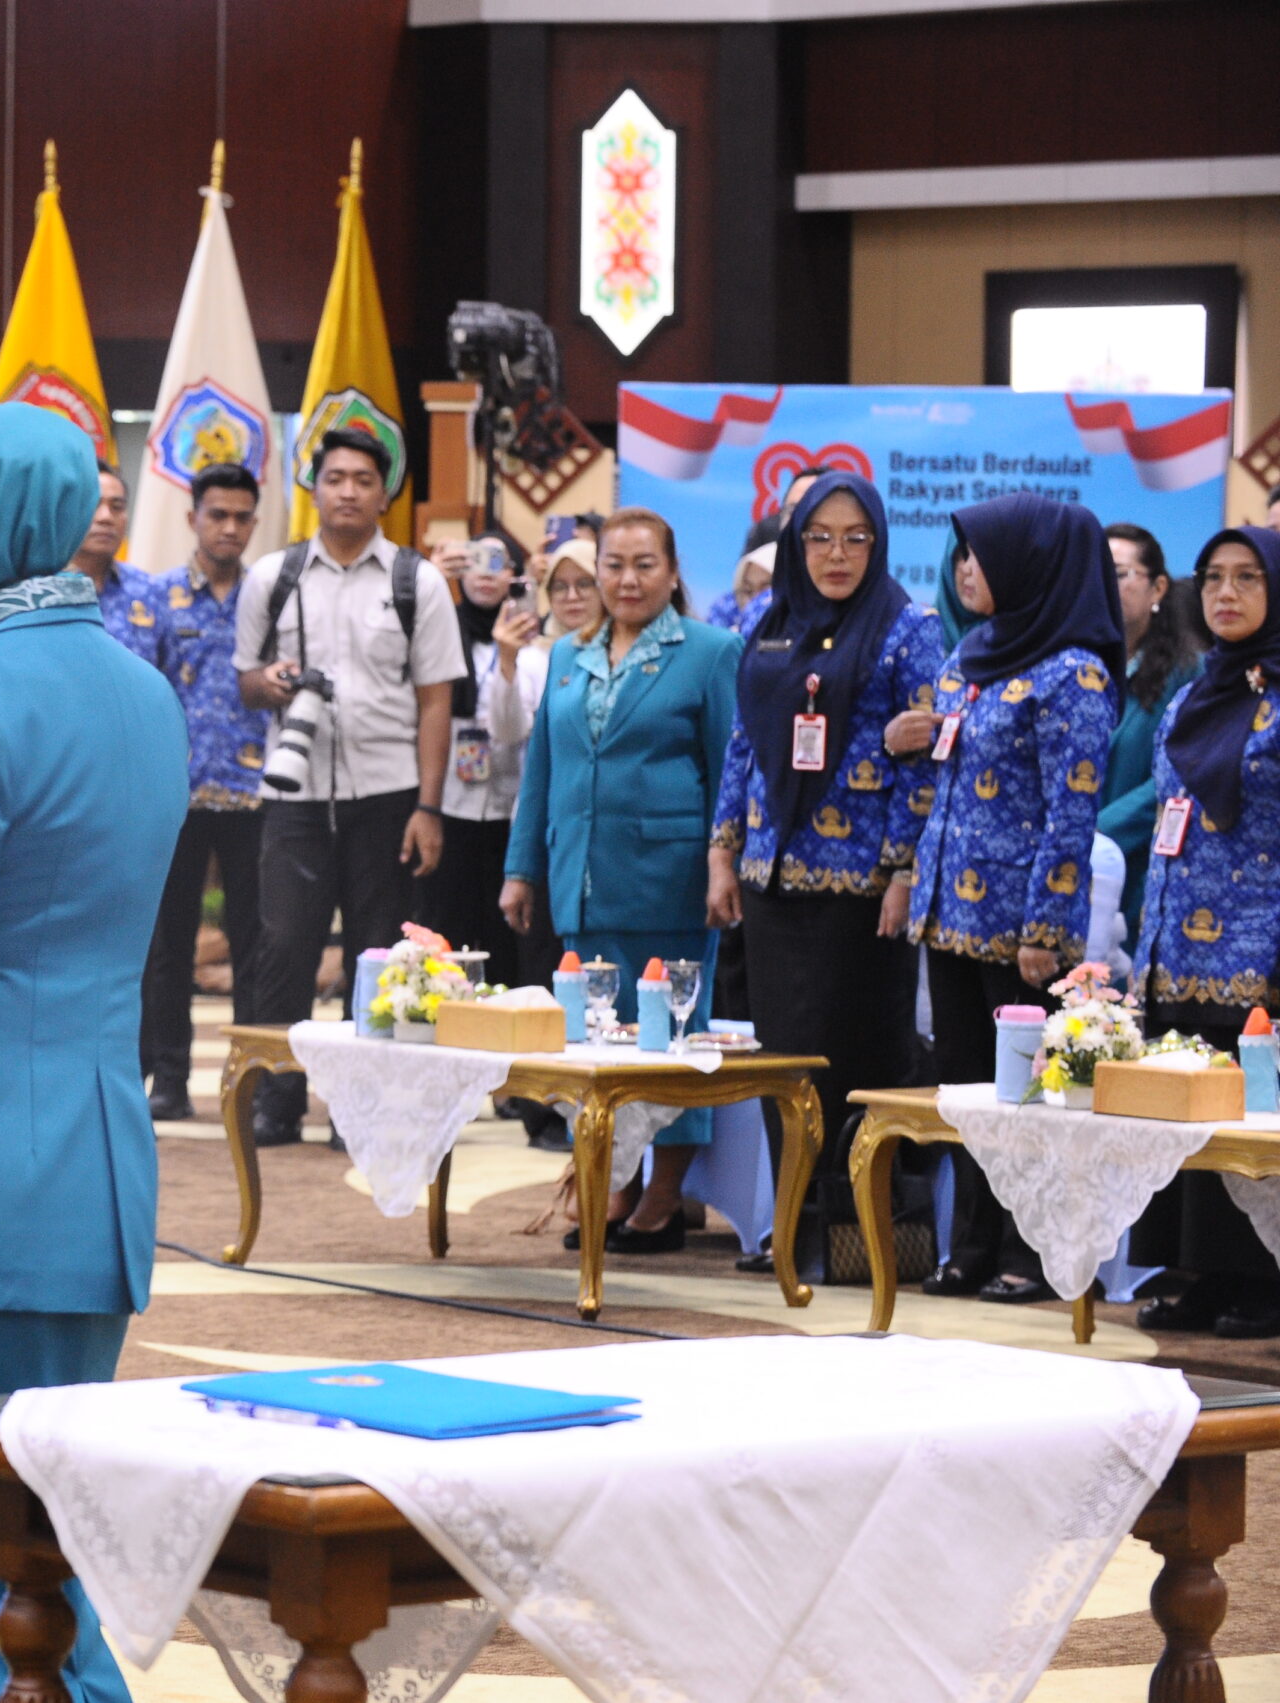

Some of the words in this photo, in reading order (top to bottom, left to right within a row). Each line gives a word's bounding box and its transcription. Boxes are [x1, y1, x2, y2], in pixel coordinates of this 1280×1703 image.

[889, 451, 977, 473] Bersatu
[983, 453, 1092, 476] Berdaulat
[889, 479, 965, 504] Rakyat
[888, 506, 950, 527] Indon
